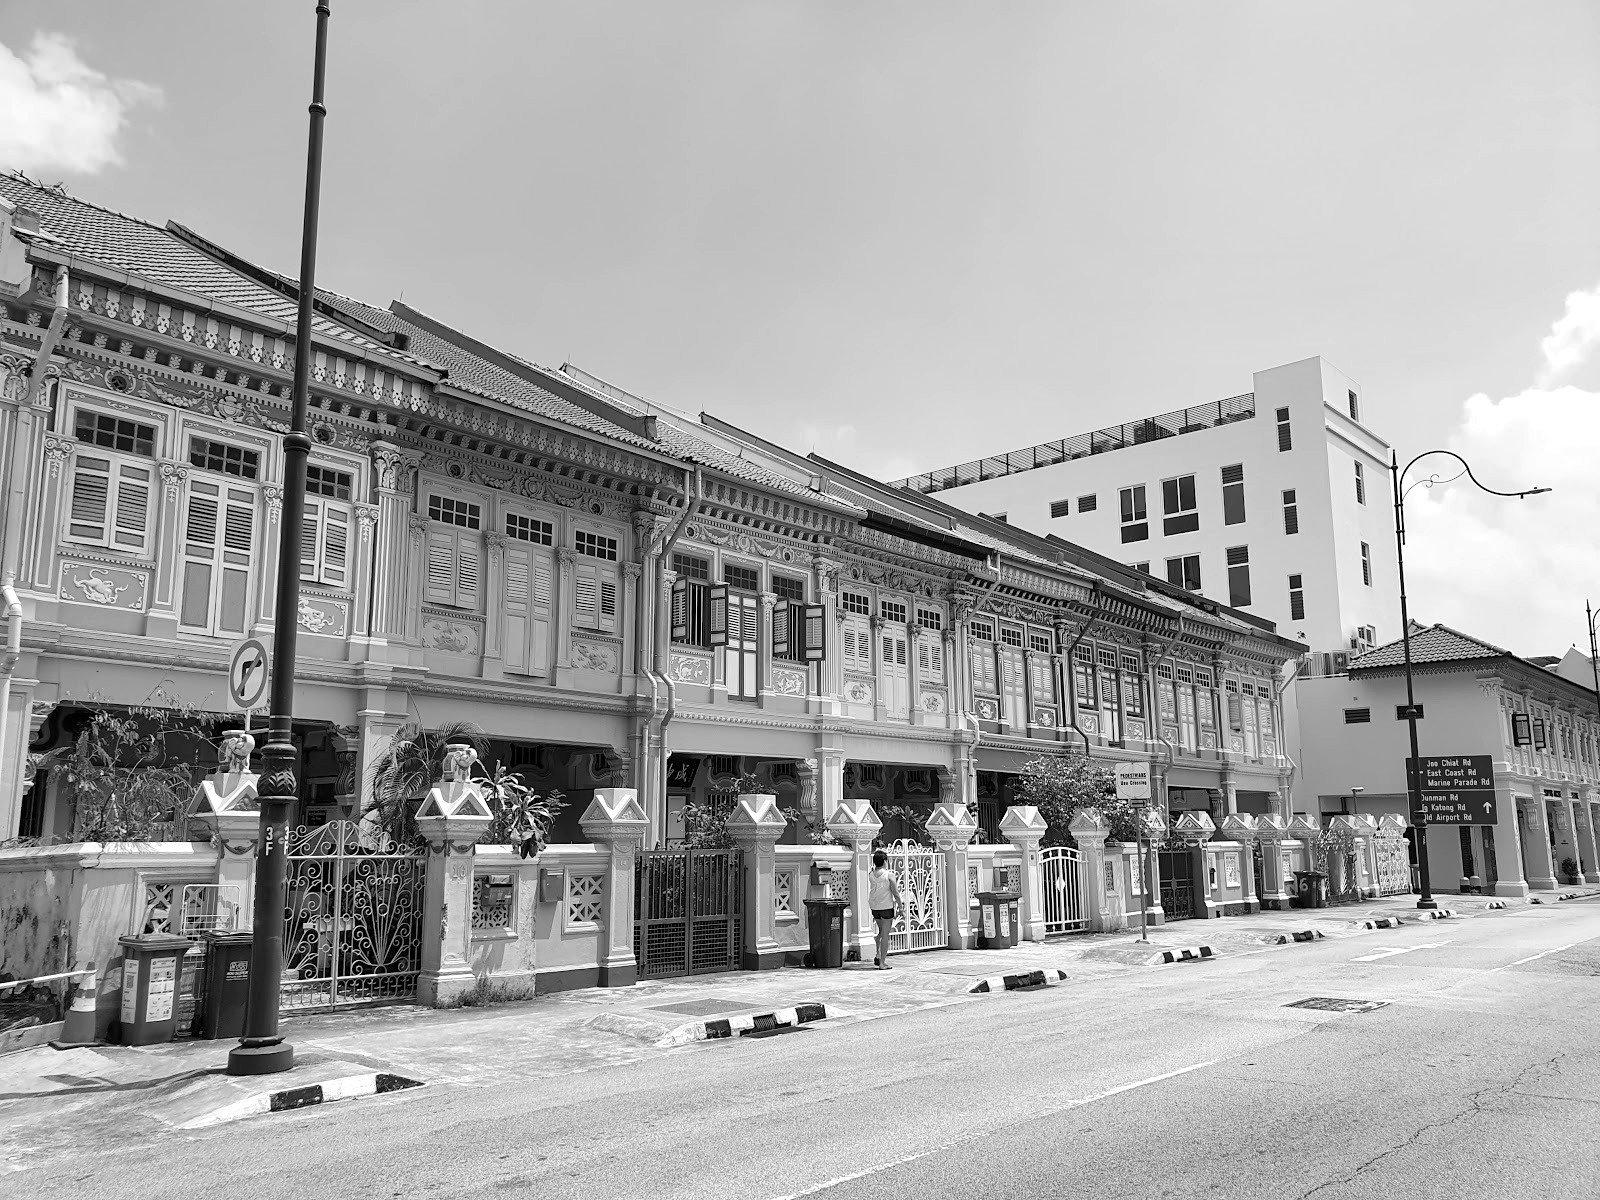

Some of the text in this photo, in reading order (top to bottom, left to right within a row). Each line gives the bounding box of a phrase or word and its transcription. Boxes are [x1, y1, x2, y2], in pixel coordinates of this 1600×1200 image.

[1442, 759, 1459, 767] Chiat
[1431, 804, 1454, 812] Katong
[1436, 814, 1460, 822] Airport
[266, 826, 273, 840] 3
[265, 841, 273, 856] F
